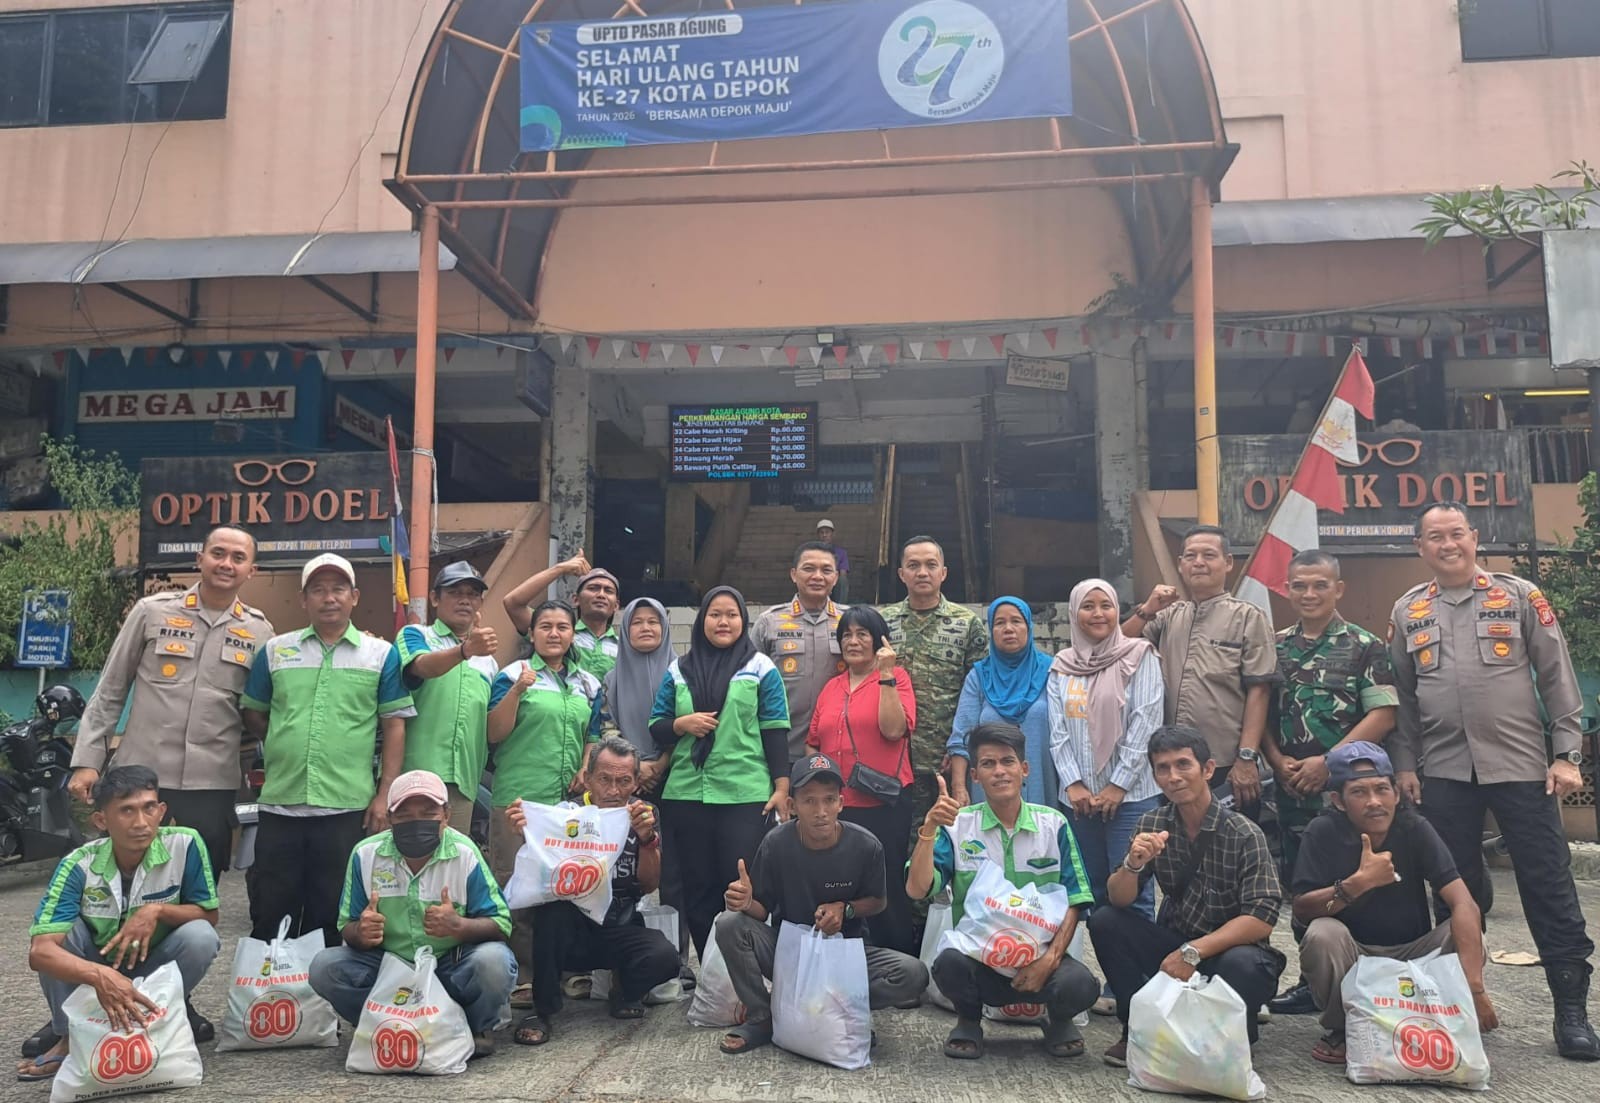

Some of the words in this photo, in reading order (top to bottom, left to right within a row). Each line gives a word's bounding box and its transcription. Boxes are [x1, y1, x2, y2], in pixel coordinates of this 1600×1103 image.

[592, 25, 628, 42] UPTD
[631, 22, 677, 40] PASAR
[679, 18, 727, 37] AGUNG
[576, 44, 681, 68] SELAMAT
[577, 68, 630, 88] HARI
[638, 63, 715, 84] ULANG
[721, 56, 800, 79] TAHUN
[577, 89, 640, 108] KE-27
[648, 84, 707, 104] KOTA
[714, 77, 790, 100] DEPOK
[577, 112, 610, 122] TAHUN
[612, 111, 636, 121] 2026
[711, 104, 752, 118] DEPOK
[83, 392, 196, 418] MEGA
[205, 389, 289, 414] JAM
[678, 414, 741, 422] PERKEMBANGAN
[770, 412, 807, 420] SEMBAKO
[1397, 472, 1518, 508] DOEL
[152, 491, 272, 526] OPTIK
[284, 488, 389, 523] DOEL
[1381, 525, 1415, 536] KOMPUT
[1479, 610, 1516, 620] POLRI
[160, 627, 196, 640] RIZKY
[225, 636, 256, 651] POLRI
[544, 837, 560, 848] HUT
[556, 862, 600, 897] 80
[985, 896, 1002, 910] HUT
[236, 976, 253, 986] HUT
[1374, 996, 1395, 1007] HUT
[250, 999, 296, 1039] 80
[97, 1033, 153, 1080] 80
[376, 1028, 418, 1069] 80
[1400, 1025, 1456, 1071] 80
[146, 1080, 174, 1088] DEPOK
